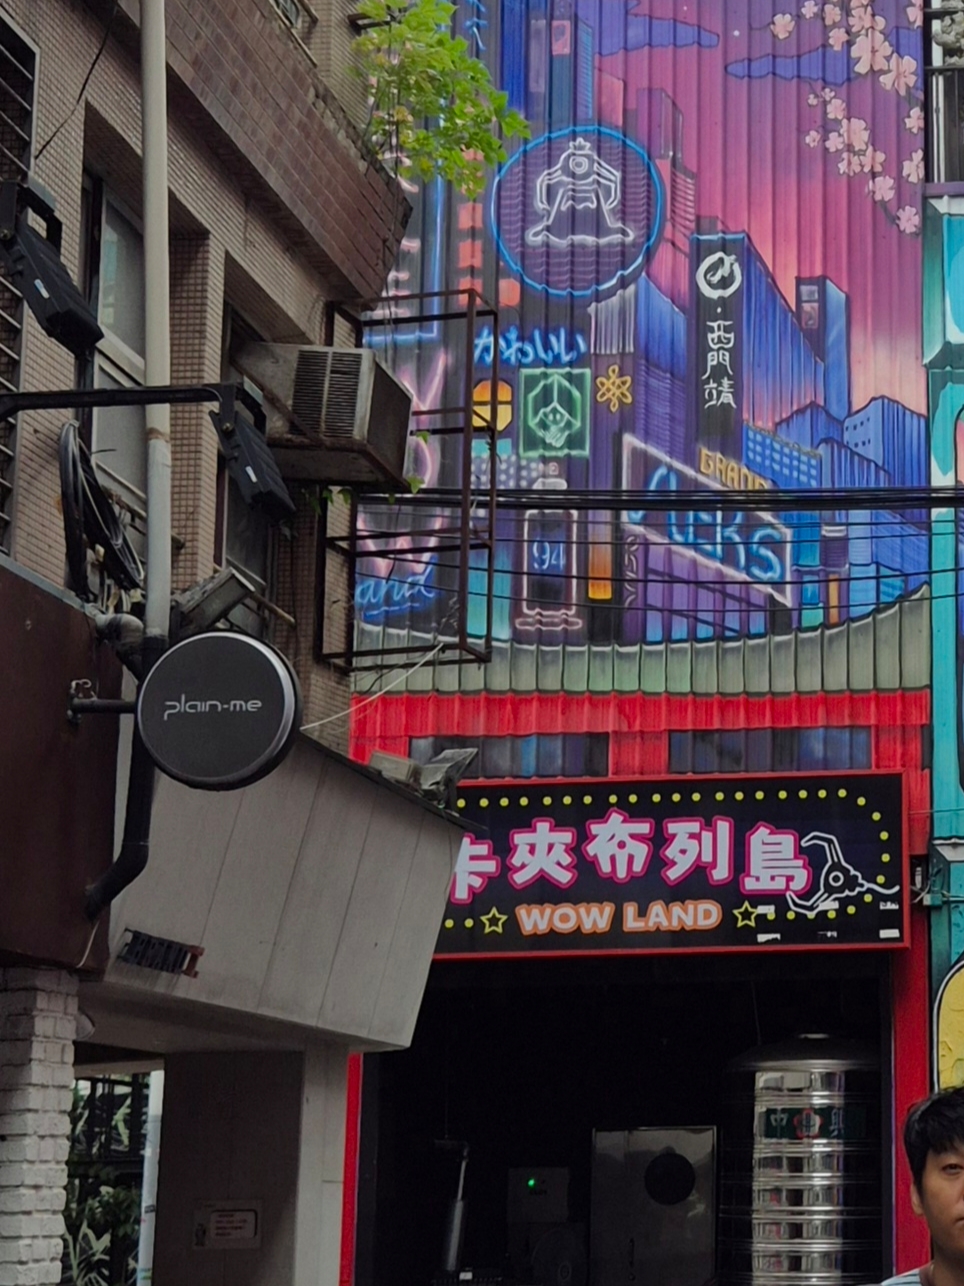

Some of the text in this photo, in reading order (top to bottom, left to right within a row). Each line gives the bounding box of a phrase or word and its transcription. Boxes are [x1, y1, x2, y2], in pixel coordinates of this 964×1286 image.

[164, 693, 262, 720] plain-me
[451, 809, 812, 904] 卡夾布列島
[516, 902, 722, 934] WOW LAND
